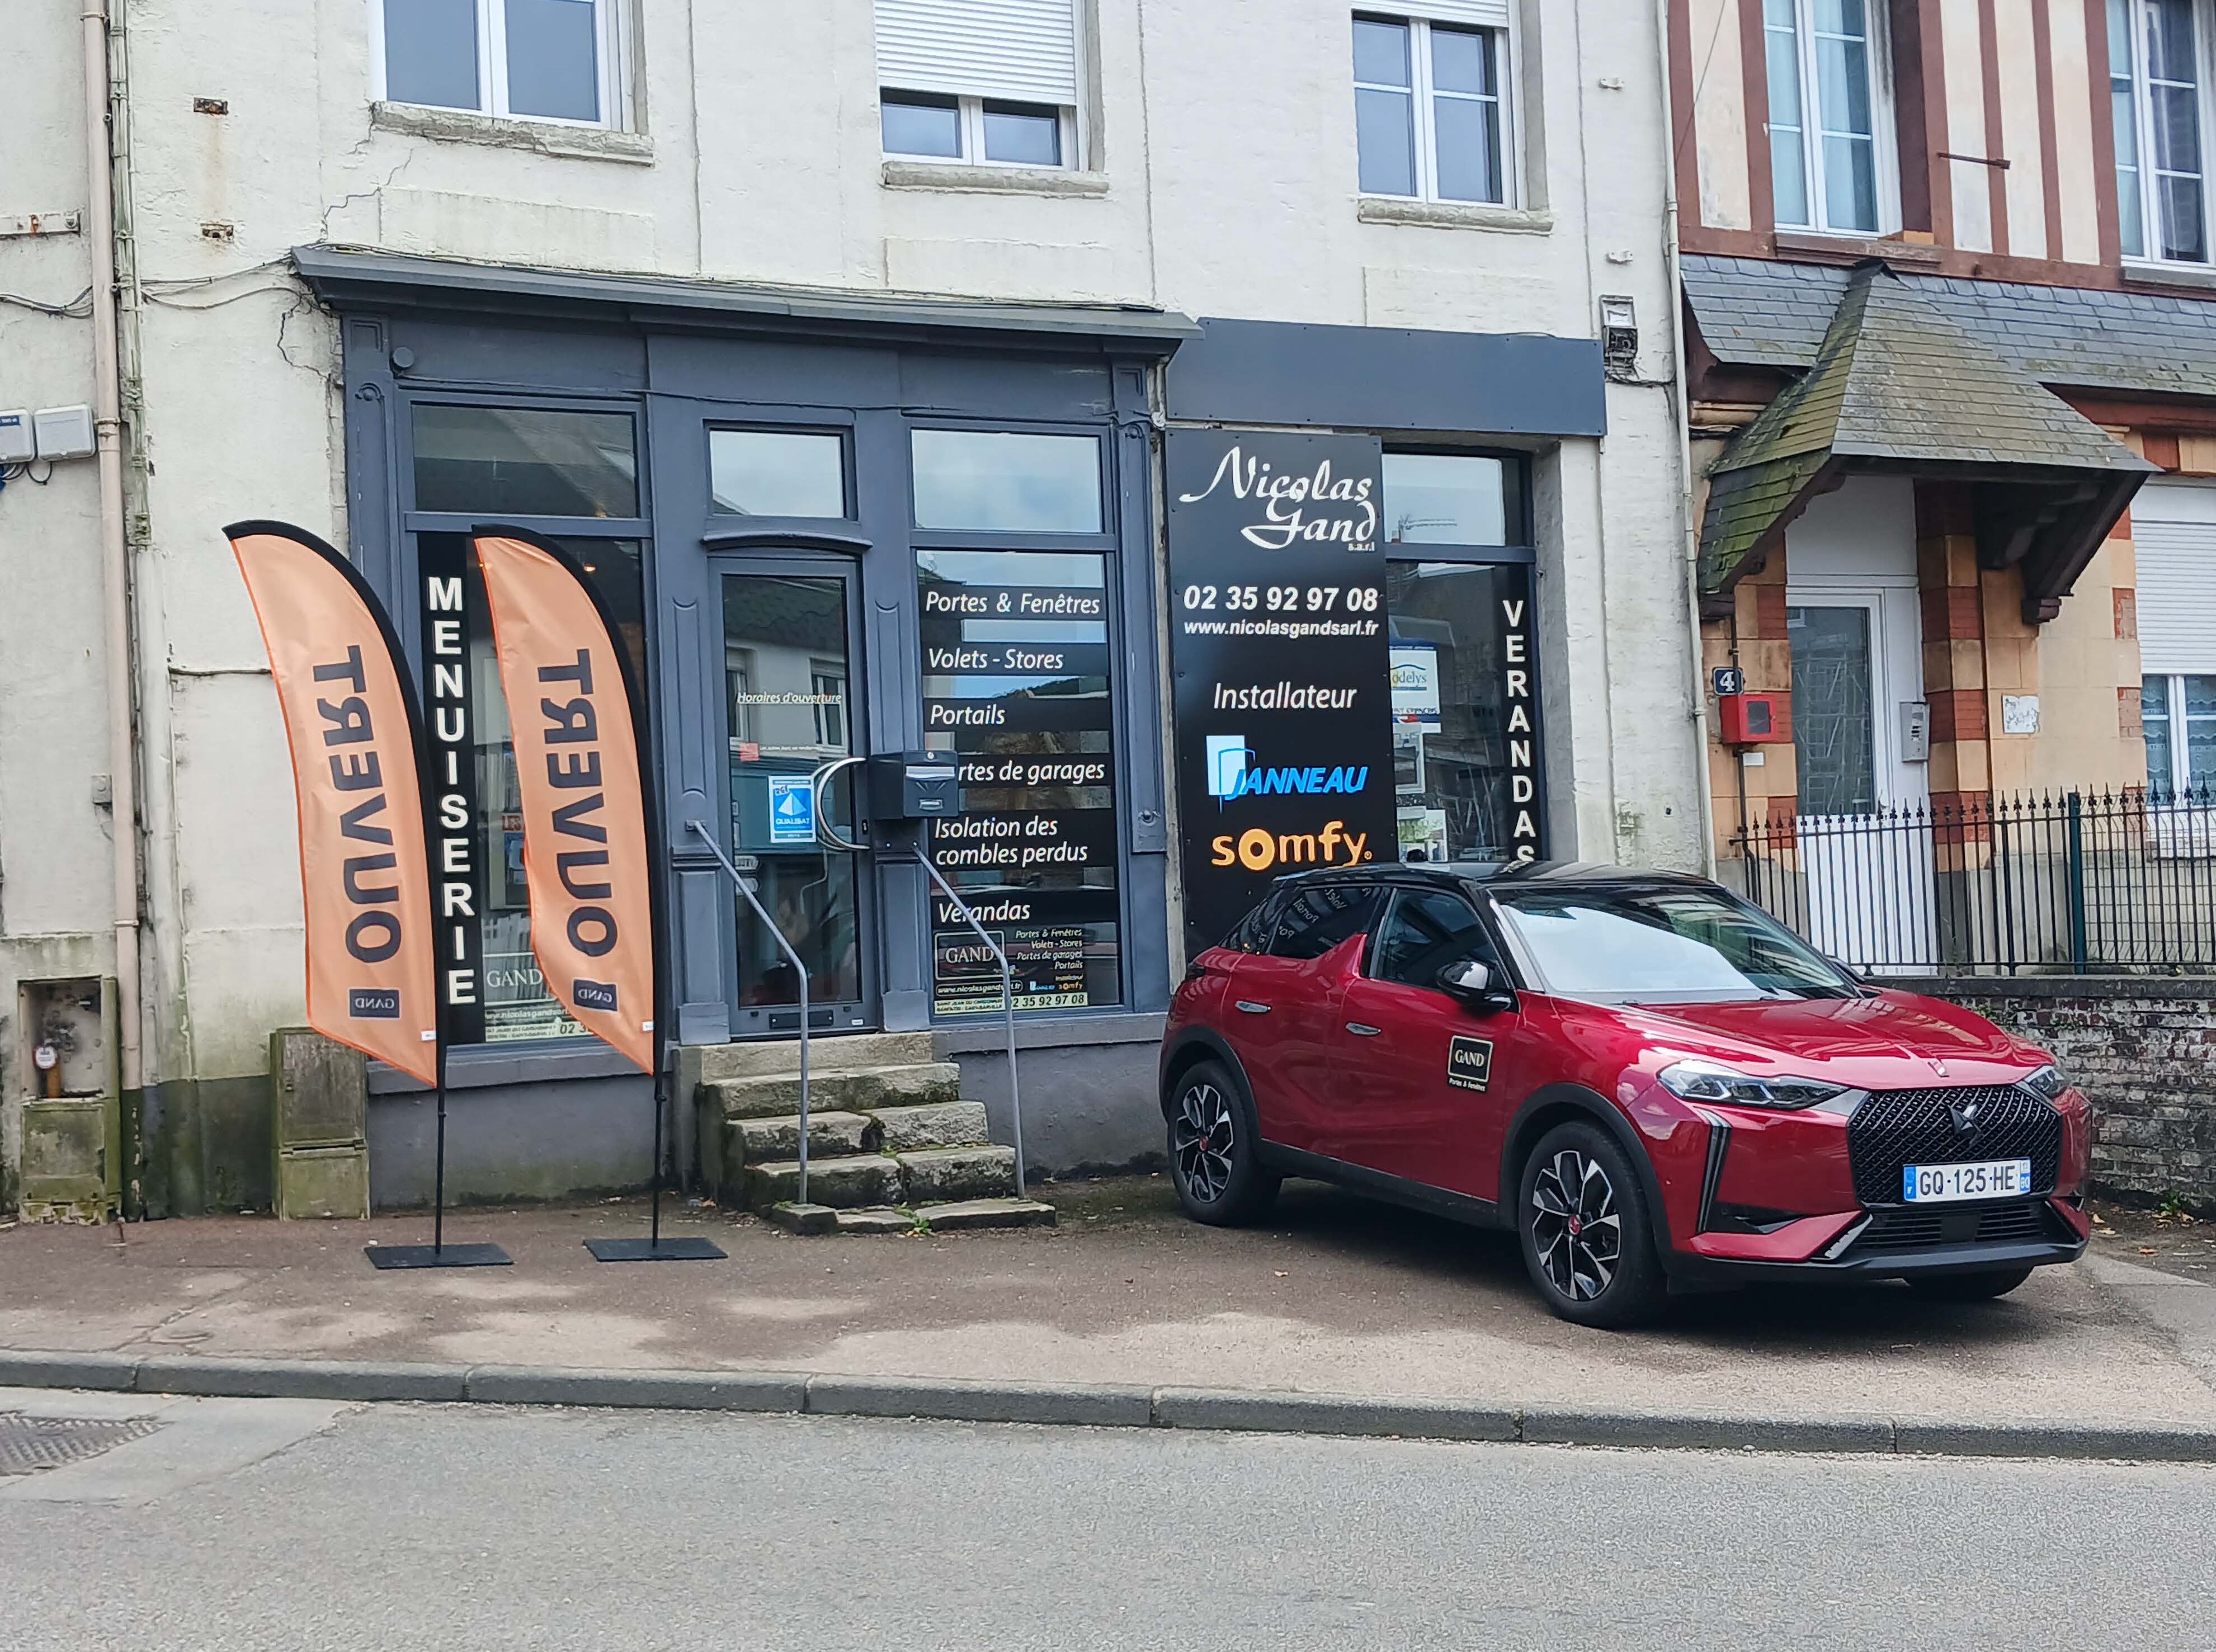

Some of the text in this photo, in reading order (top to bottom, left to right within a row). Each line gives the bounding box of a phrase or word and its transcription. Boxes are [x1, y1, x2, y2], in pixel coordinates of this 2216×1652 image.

[1179, 446, 1373, 504] Nicolas
[1240, 490, 1376, 549] Gand
[926, 591, 1100, 614] Portes & Fenêtres
[1184, 585, 1378, 612] 02 35 92 97 08
[1184, 618, 1379, 639] www.nicolasgandsarl.fr
[928, 647, 988, 669] Volets
[1004, 648, 1064, 670] Stores
[1720, 671, 1734, 692] 4
[737, 691, 842, 703] Horaires d'ouverture
[1213, 681, 1357, 711] Installateur
[930, 704, 1006, 725] Portails
[1502, 600, 1536, 862] VERANDAS
[958, 760, 1105, 785] rtes de garages
[427, 576, 477, 1005] MENUISERIE
[935, 815, 1058, 839] Isolation des
[935, 841, 1088, 867] combles perdus
[1211, 820, 1366, 870] somfy
[1016, 929, 1040, 940] Portes
[1031, 940, 1053, 949] Volets
[1060, 939, 1083, 948] Stores
[945, 946, 994, 964] GAND
[1017, 950, 1083, 961] Portes de garages
[1054, 961, 1083, 970] Portails
[486, 969, 543, 988] GAND
[1022, 997, 1036, 1007] 35
[1039, 996, 1052, 1006] 92
[1055, 995, 1068, 1005] 97
[1071, 994, 1085, 1004] 08
[559, 1023, 576, 1035] 02
[1455, 1049, 1485, 1067] GAND
